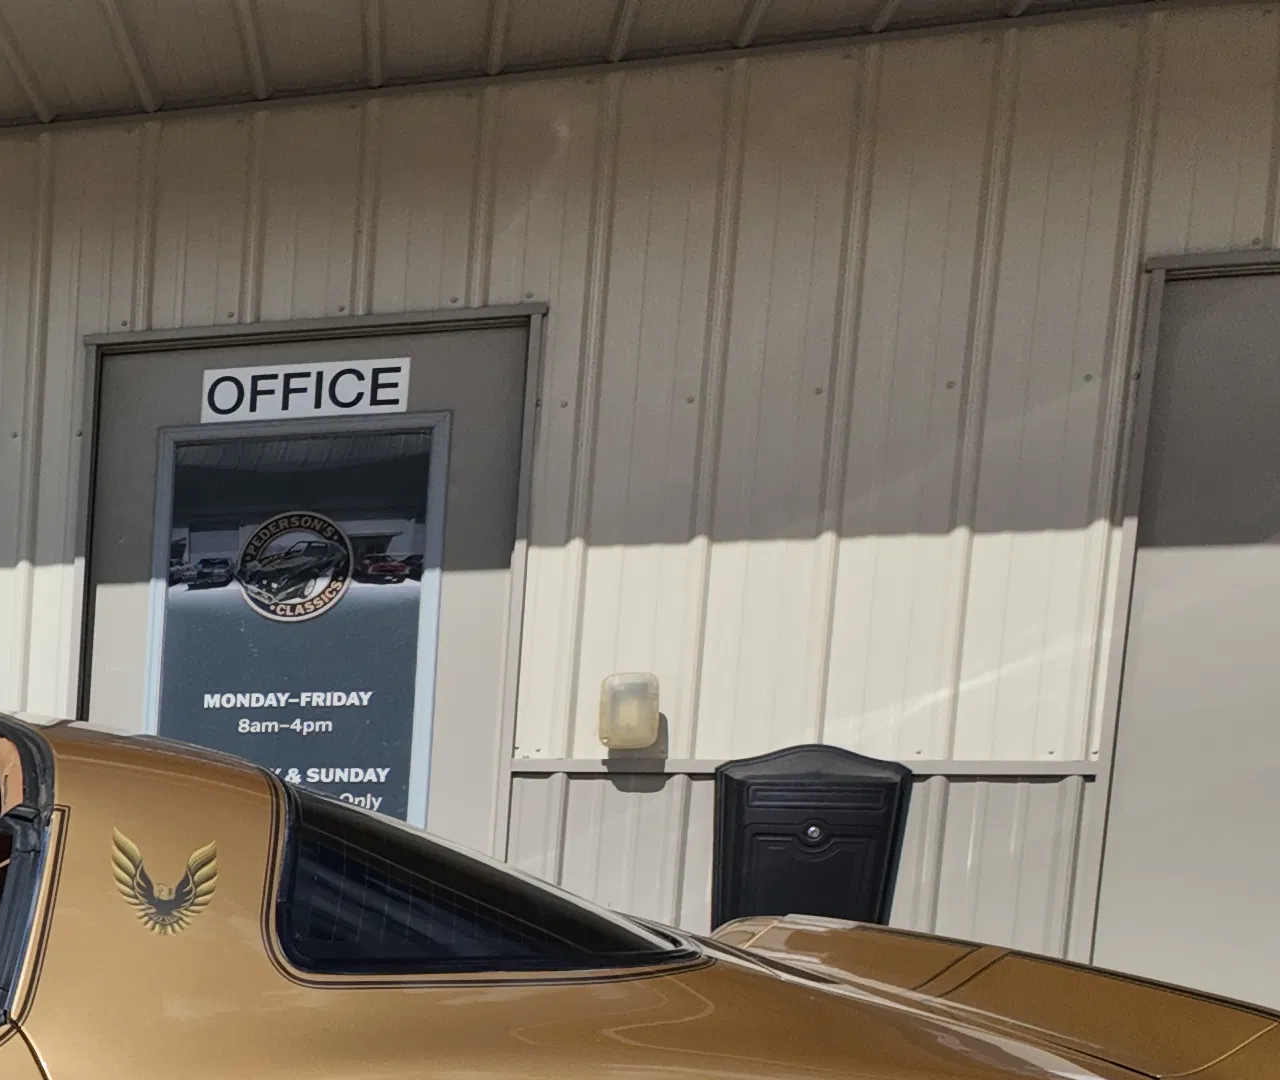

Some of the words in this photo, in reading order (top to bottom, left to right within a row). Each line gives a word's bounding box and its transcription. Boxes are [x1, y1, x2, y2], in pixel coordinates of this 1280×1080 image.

[207, 366, 402, 415] OFFICE
[247, 516, 335, 555] PEDERSON'S
[275, 580, 343, 616] CLASSICS
[284, 767, 302, 785] &
[306, 767, 391, 783] SUNDAY
